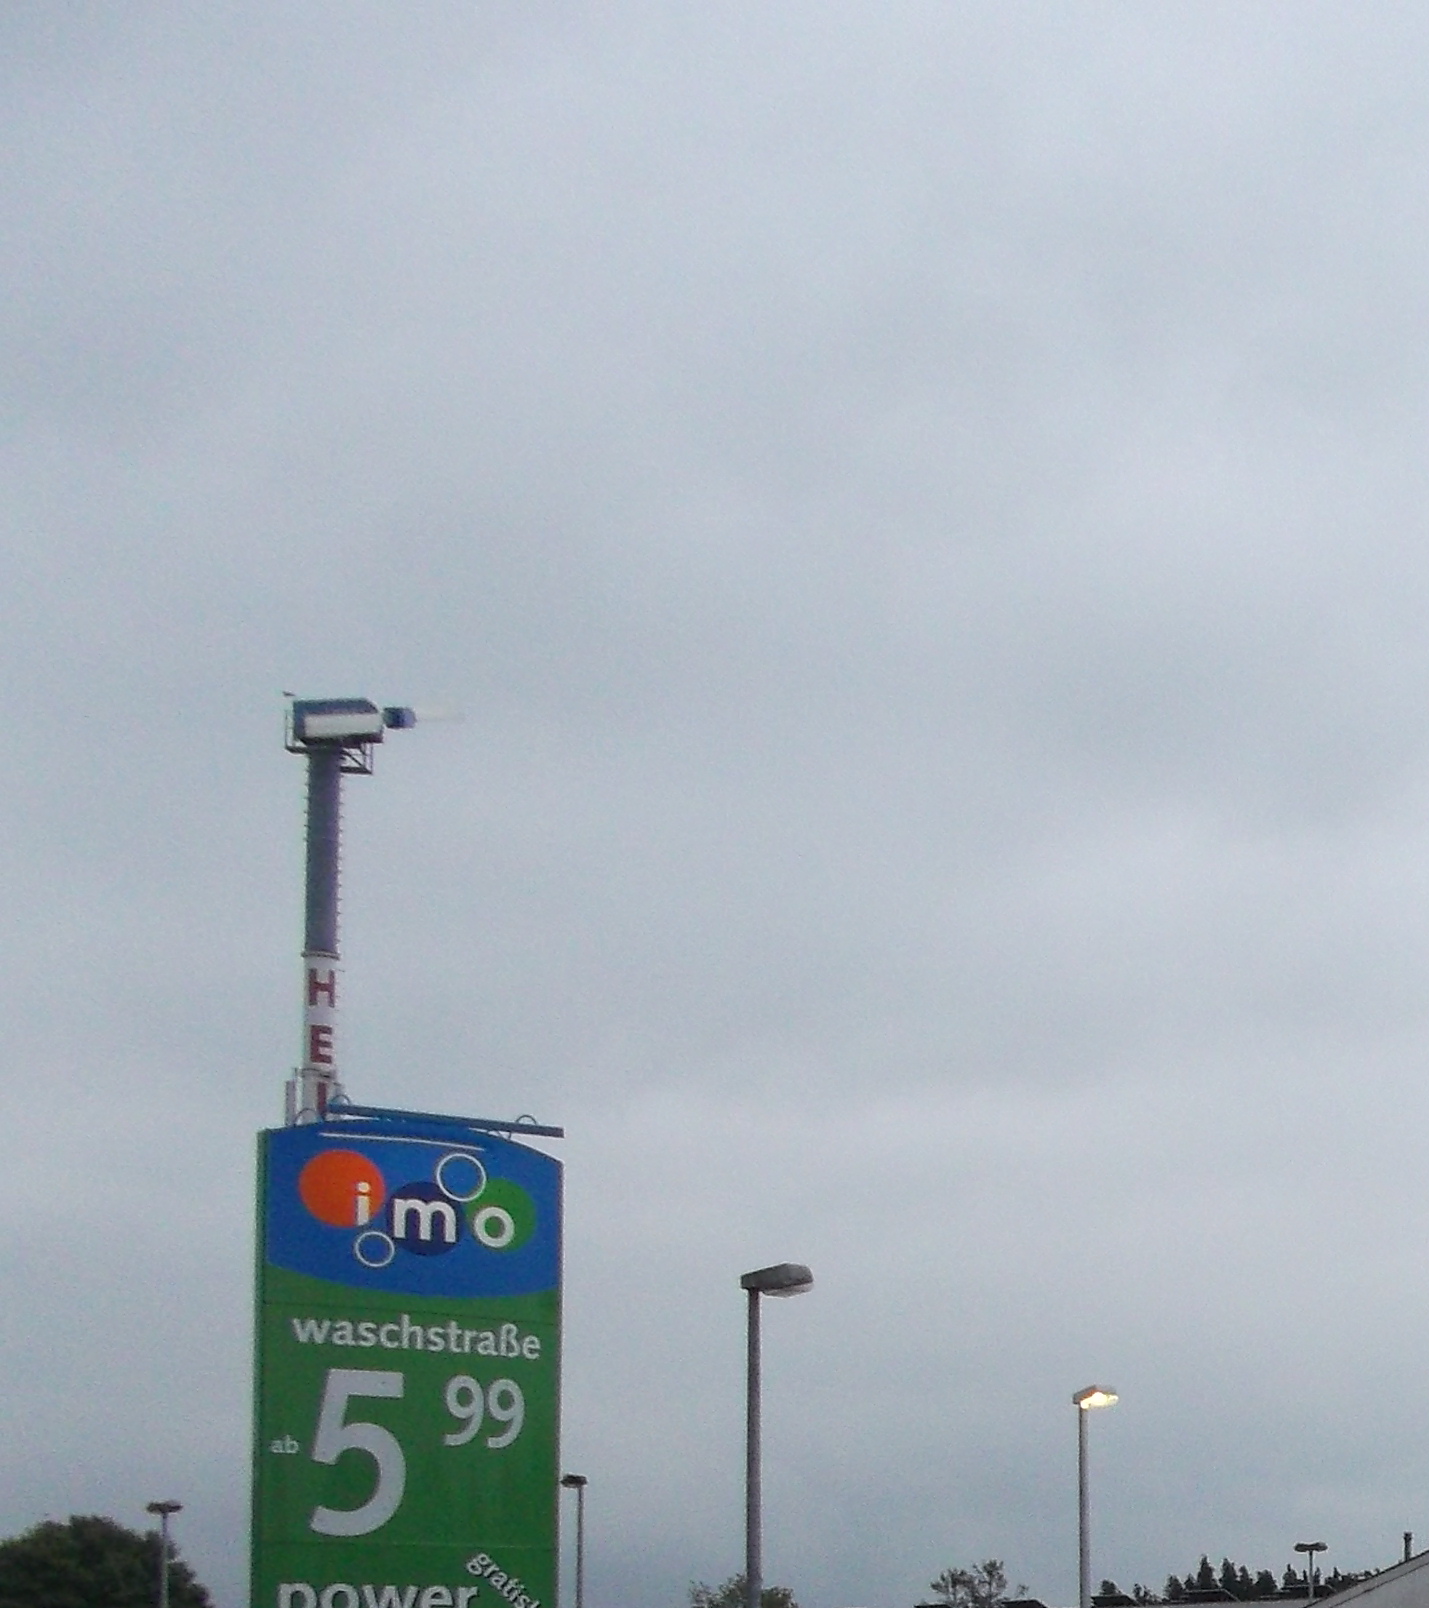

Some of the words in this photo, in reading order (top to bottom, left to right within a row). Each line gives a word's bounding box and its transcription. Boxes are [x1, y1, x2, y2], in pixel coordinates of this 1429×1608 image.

[355, 1181, 516, 1249] imo
[290, 1314, 542, 1360] waschstraße
[271, 1435, 300, 1455] ab
[309, 1368, 407, 1538] 5
[444, 1374, 526, 1449] 99
